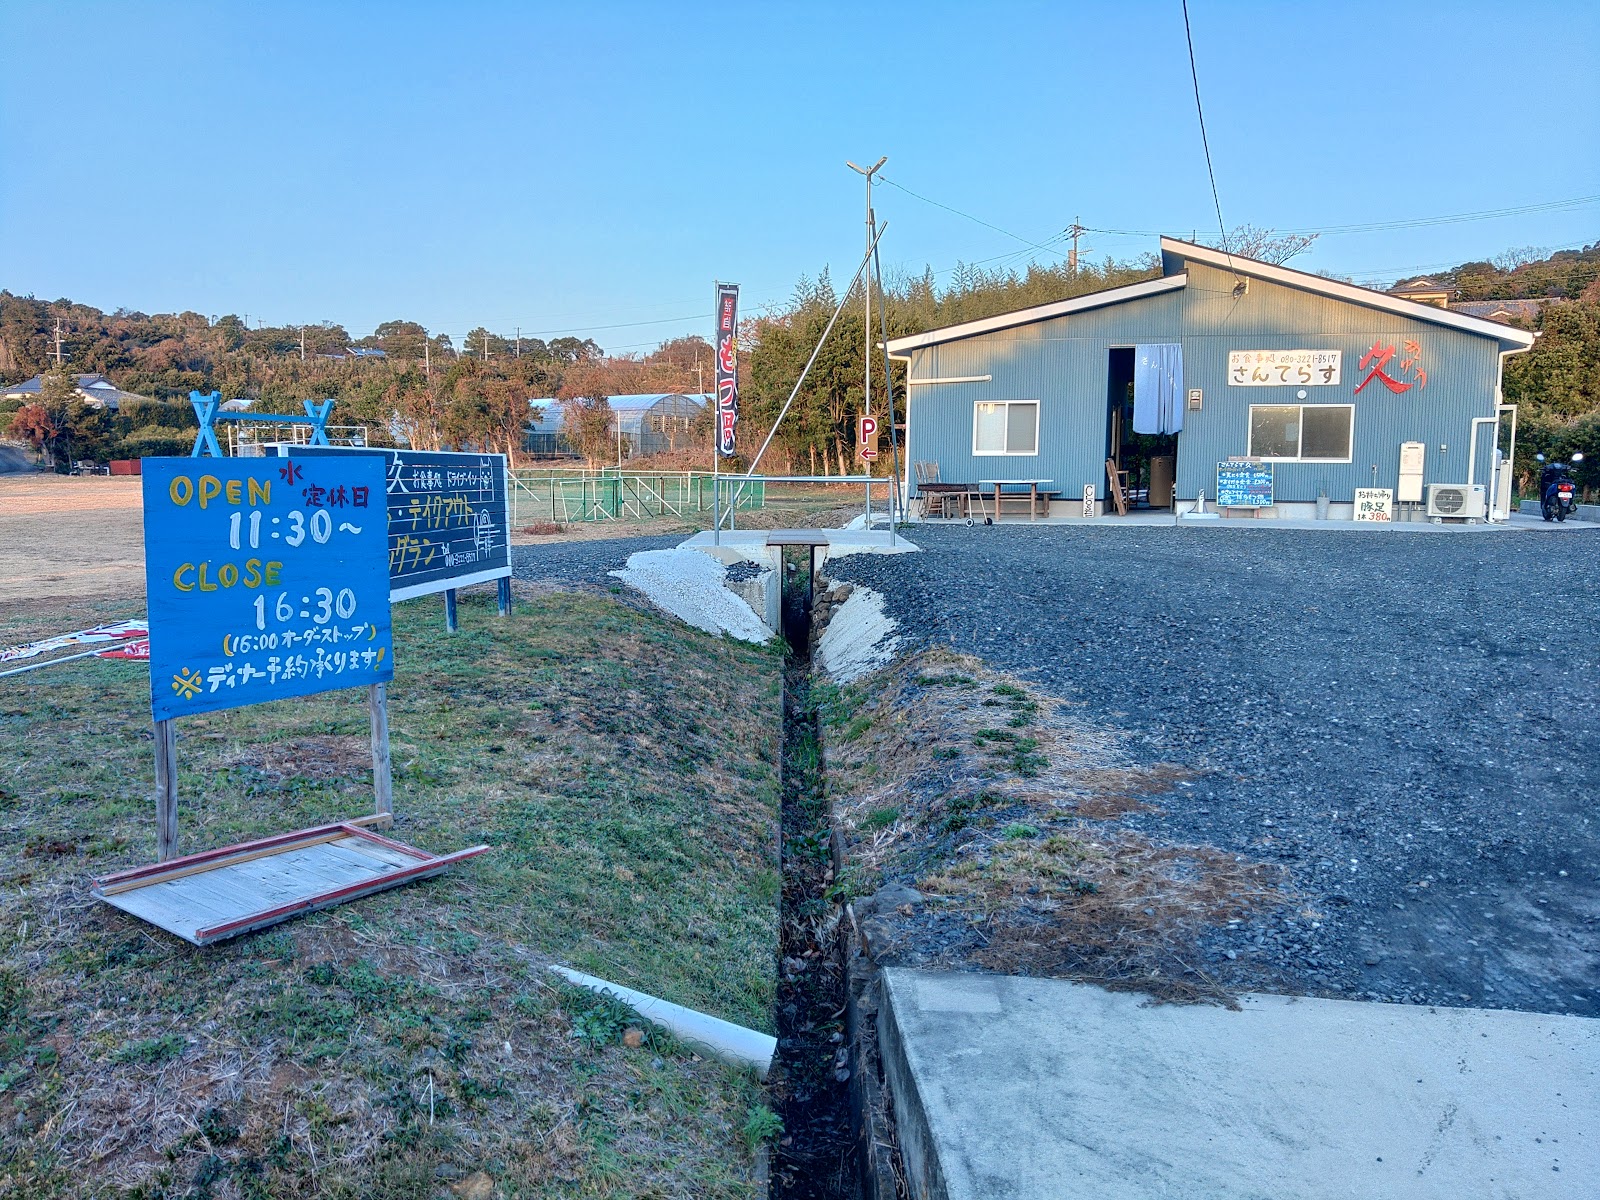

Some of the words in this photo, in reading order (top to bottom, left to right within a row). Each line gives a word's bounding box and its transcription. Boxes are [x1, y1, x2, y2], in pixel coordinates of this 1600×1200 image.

[1231, 353, 1276, 364] お食事処
[1233, 363, 1336, 384] さんてらす
[1353, 339, 1414, 395] 久
[861, 418, 877, 444] P
[169, 475, 272, 509] OPEN
[279, 460, 304, 486] 水
[302, 483, 370, 509] 定休日
[412, 469, 443, 491] お食事処
[1360, 501, 1385, 512] 豚足
[173, 558, 284, 592] CLOSE
[253, 587, 357, 631] 16:30
